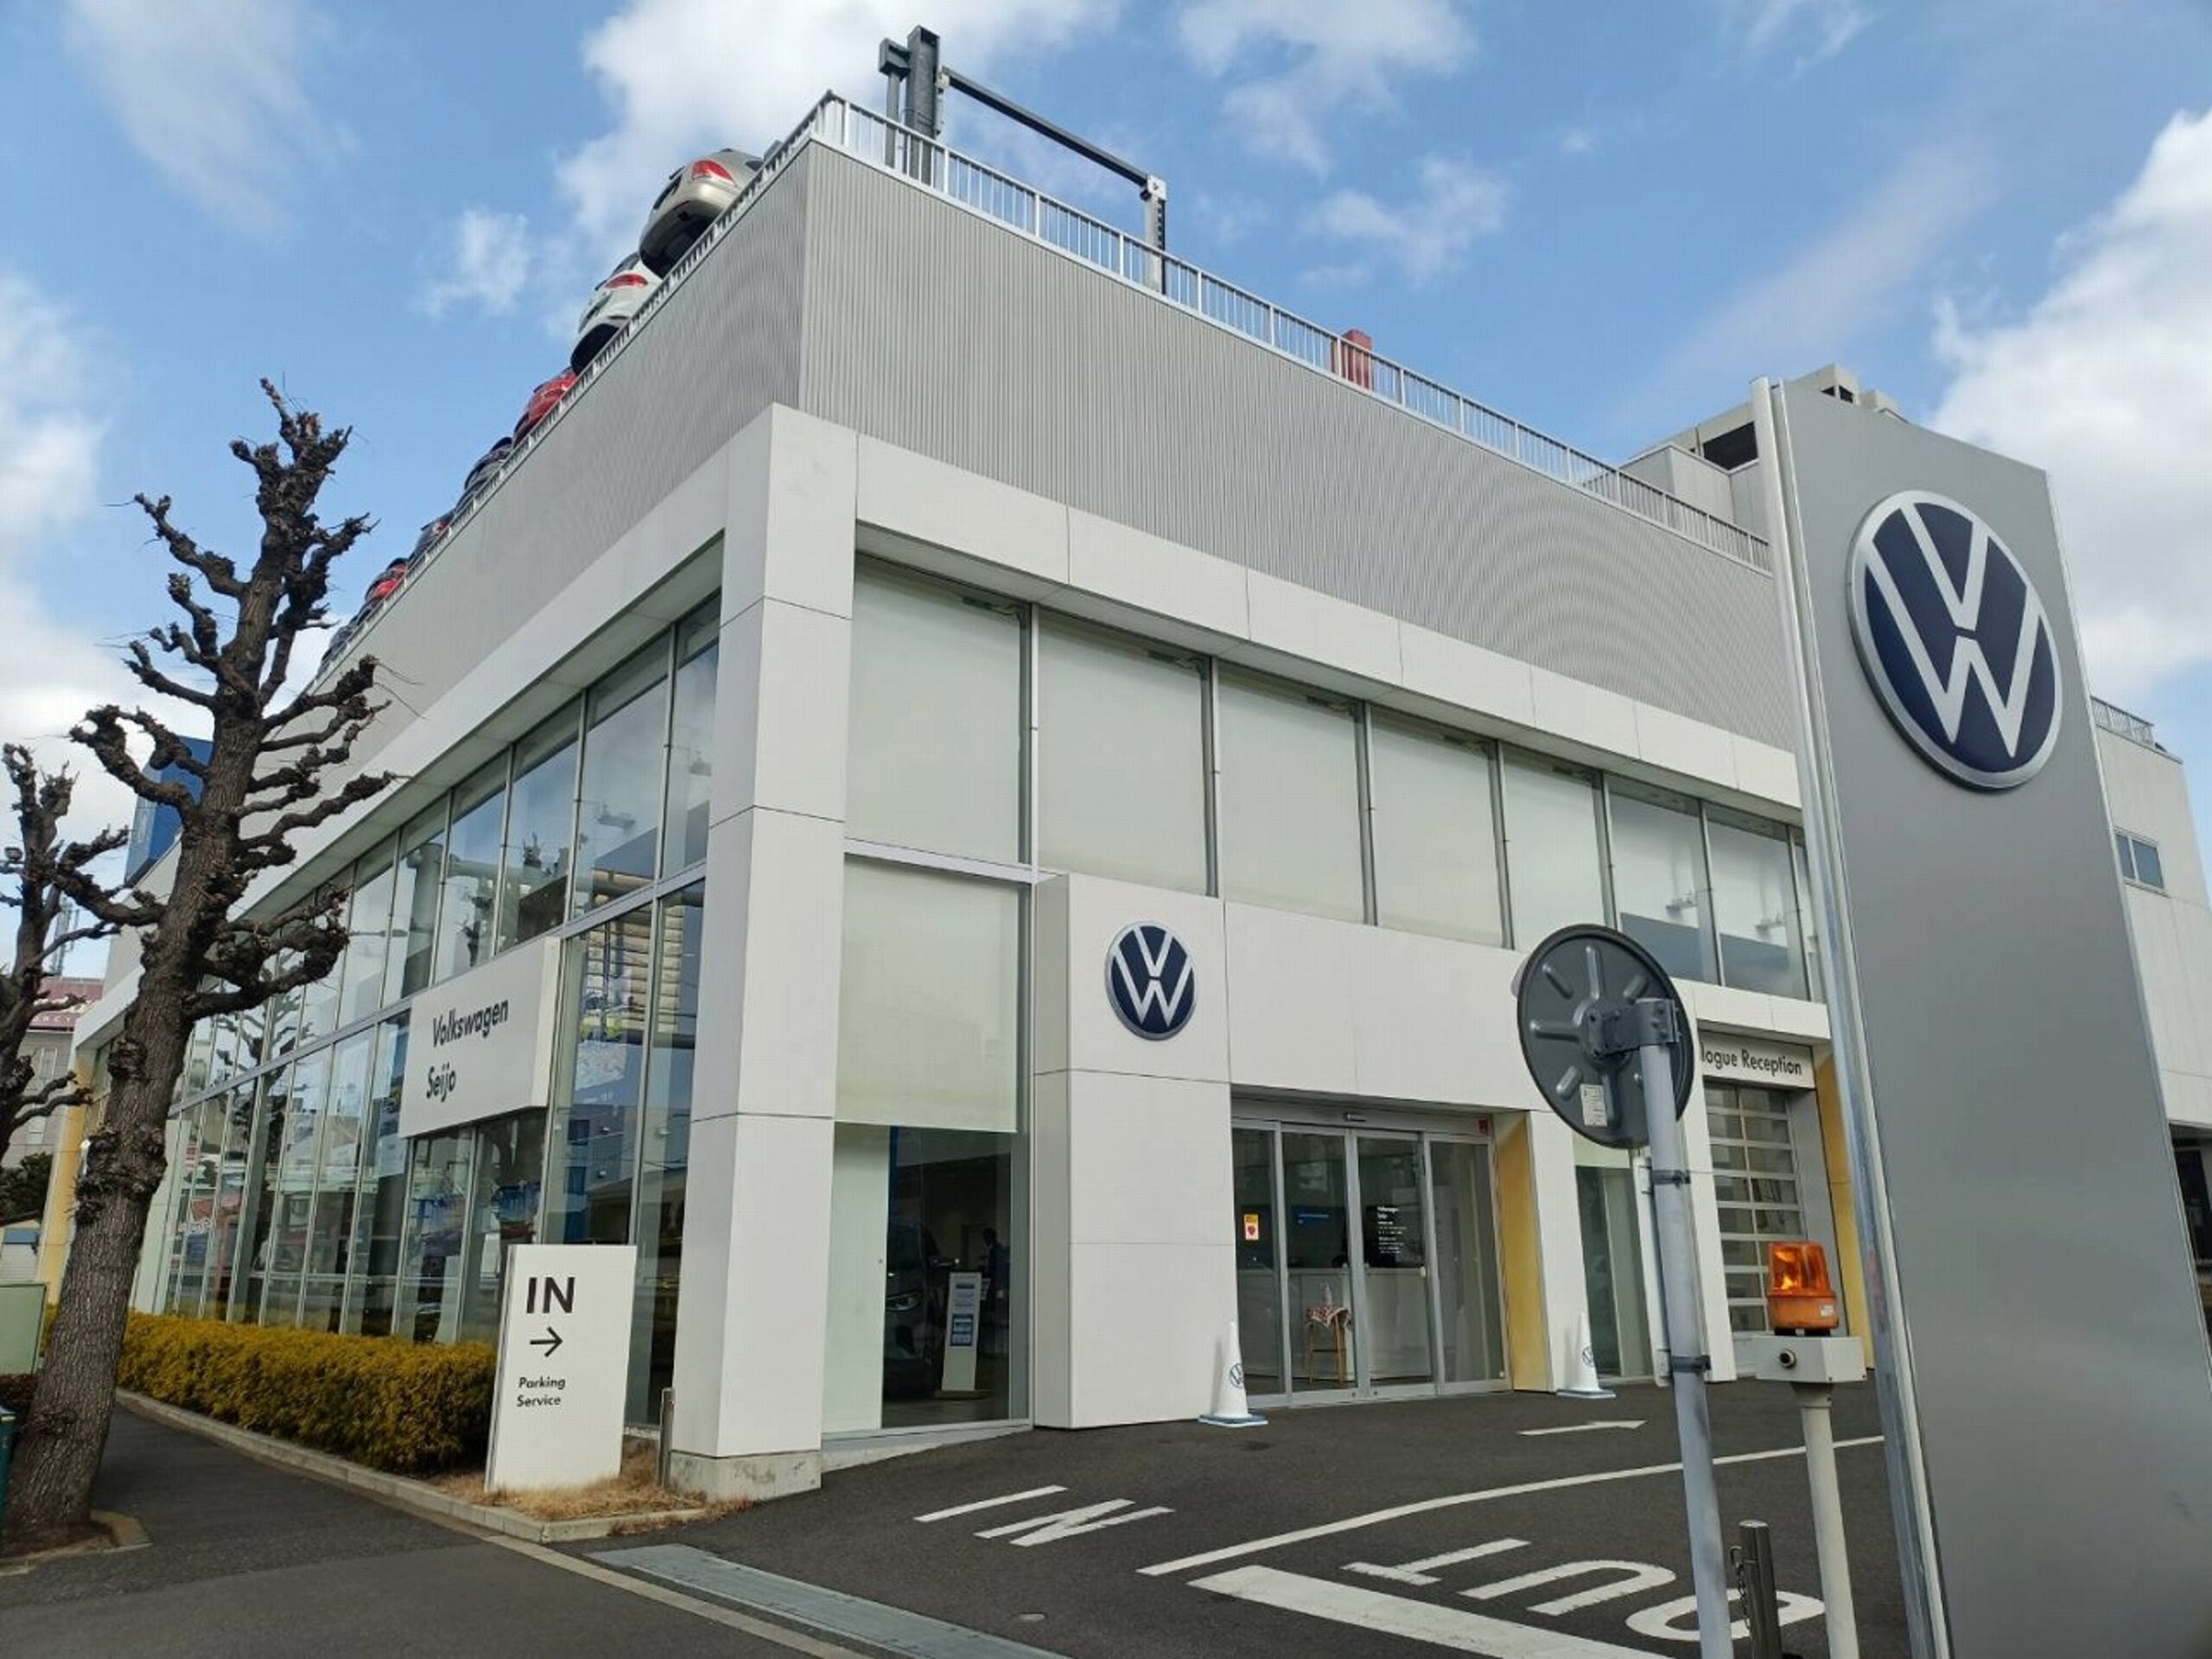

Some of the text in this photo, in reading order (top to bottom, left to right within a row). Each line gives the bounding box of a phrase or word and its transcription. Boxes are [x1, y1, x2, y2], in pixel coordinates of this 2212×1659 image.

[433, 1000, 509, 1048] Volkswagen
[1741, 1048, 1802, 1077] Reception
[426, 1061, 456, 1103] Seijo
[526, 1277, 575, 1314] IN
[517, 1395, 562, 1407] Service
[518, 1376, 566, 1390] Parking
[912, 1484, 1176, 1548] IN
